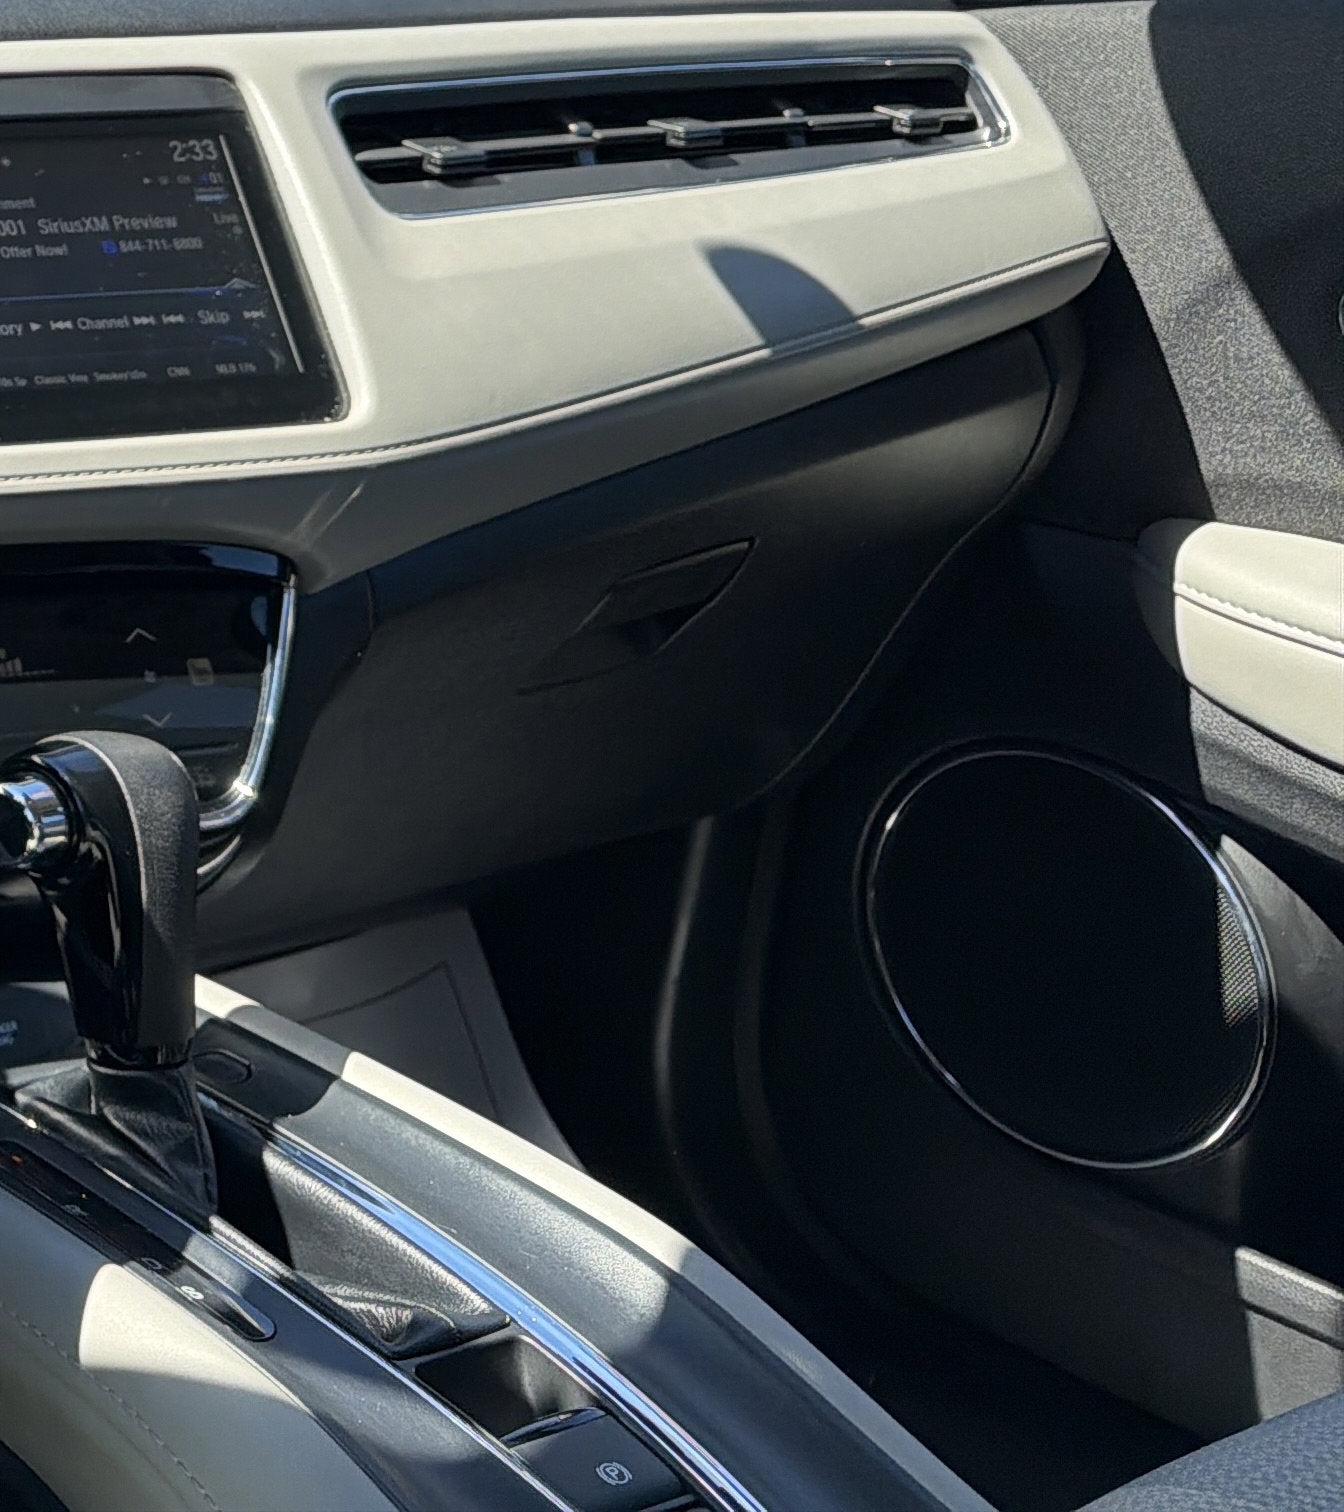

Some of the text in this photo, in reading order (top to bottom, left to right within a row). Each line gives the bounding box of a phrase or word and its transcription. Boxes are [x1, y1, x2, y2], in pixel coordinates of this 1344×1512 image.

[168, 139, 219, 163] 2:33
[37, 214, 109, 237] SiriusXM
[112, 214, 178, 232] Preview
[0, 245, 33, 260] Offer
[35, 244, 69, 258] Now!
[76, 316, 130, 331] Channel
[196, 309, 230, 325] Skip
